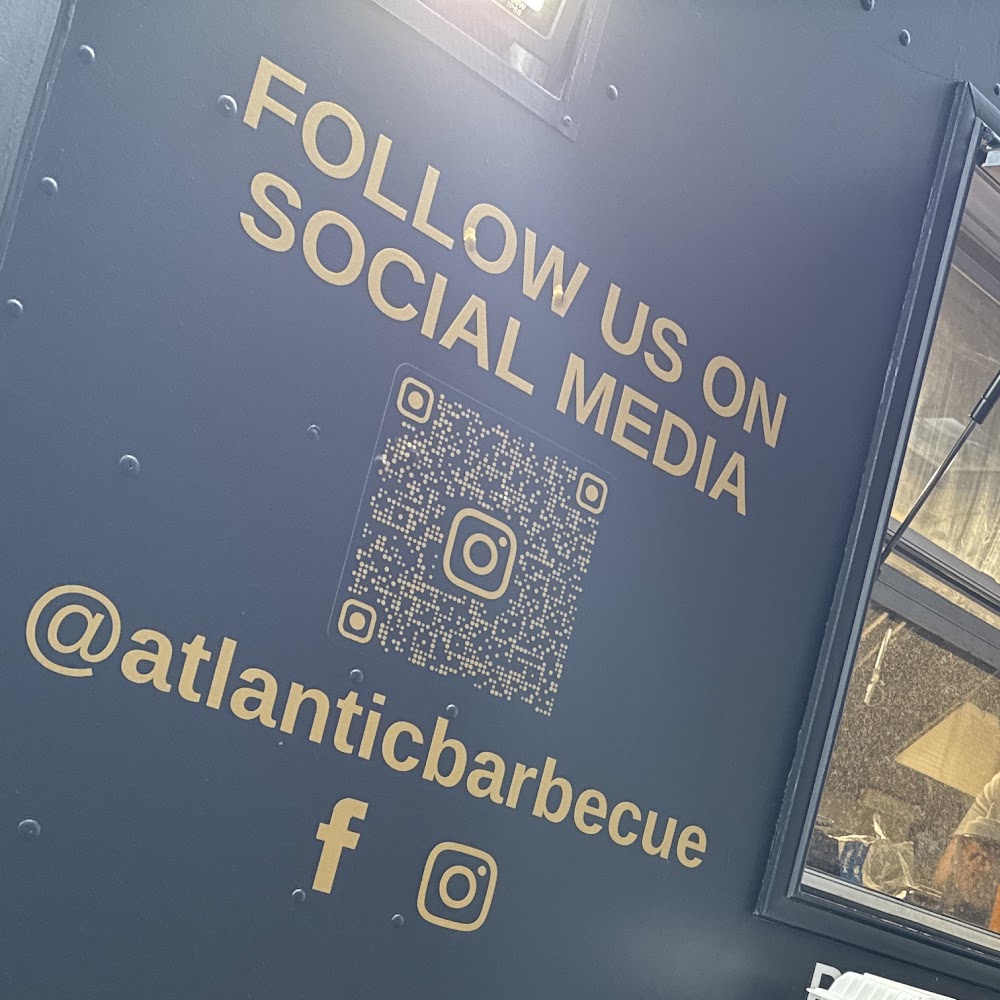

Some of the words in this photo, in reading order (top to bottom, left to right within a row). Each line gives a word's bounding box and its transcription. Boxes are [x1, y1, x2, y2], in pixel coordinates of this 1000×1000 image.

[239, 171, 535, 396] SOCIAL
[556, 352, 749, 517] MEDIA
[242, 56, 590, 318] FOLLOW
[600, 284, 689, 384] US
[702, 355, 789, 449] ON
[25, 583, 708, 873] @atlanticbarbecue
